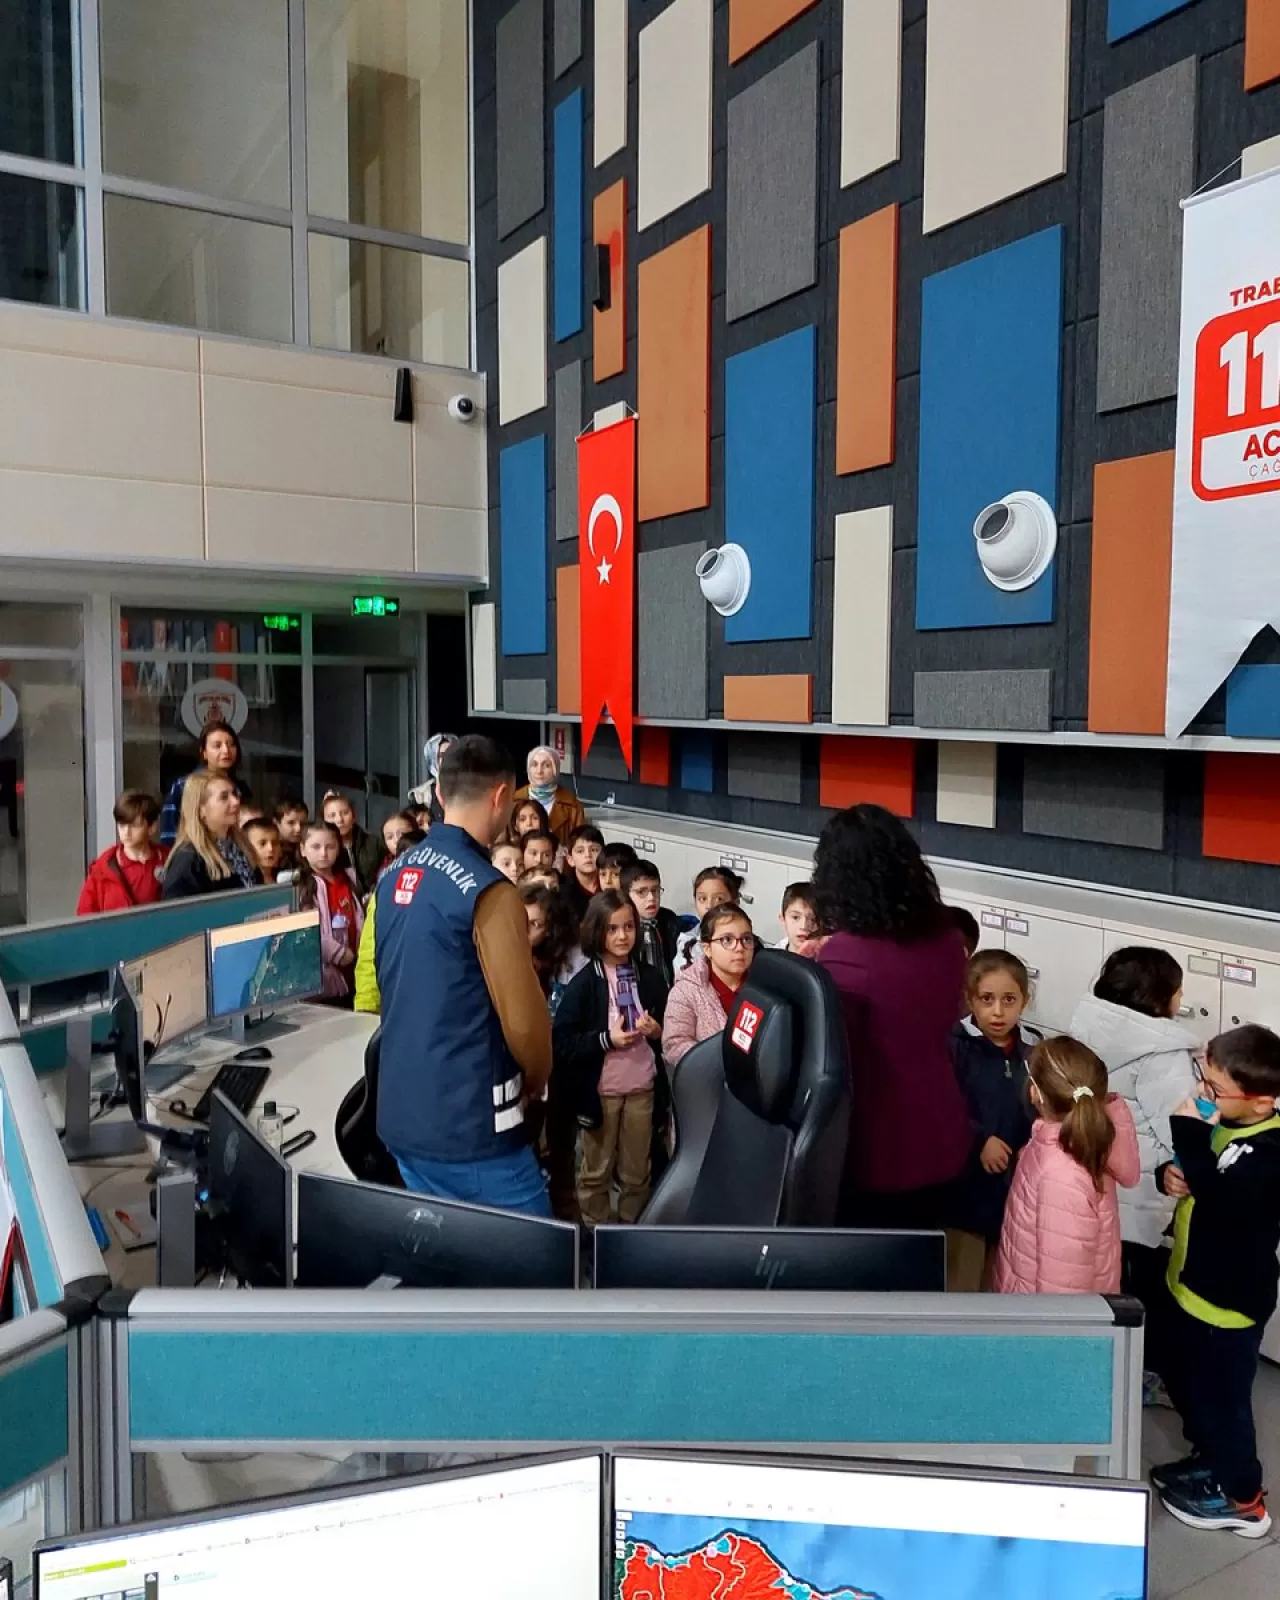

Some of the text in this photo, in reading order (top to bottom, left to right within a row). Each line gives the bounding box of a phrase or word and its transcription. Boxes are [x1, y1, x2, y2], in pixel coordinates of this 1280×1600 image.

[1243, 430, 1280, 461] AC
[401, 872, 419, 890] 112
[407, 847, 477, 895] GÜVENLİK
[739, 1007, 758, 1034] 112
